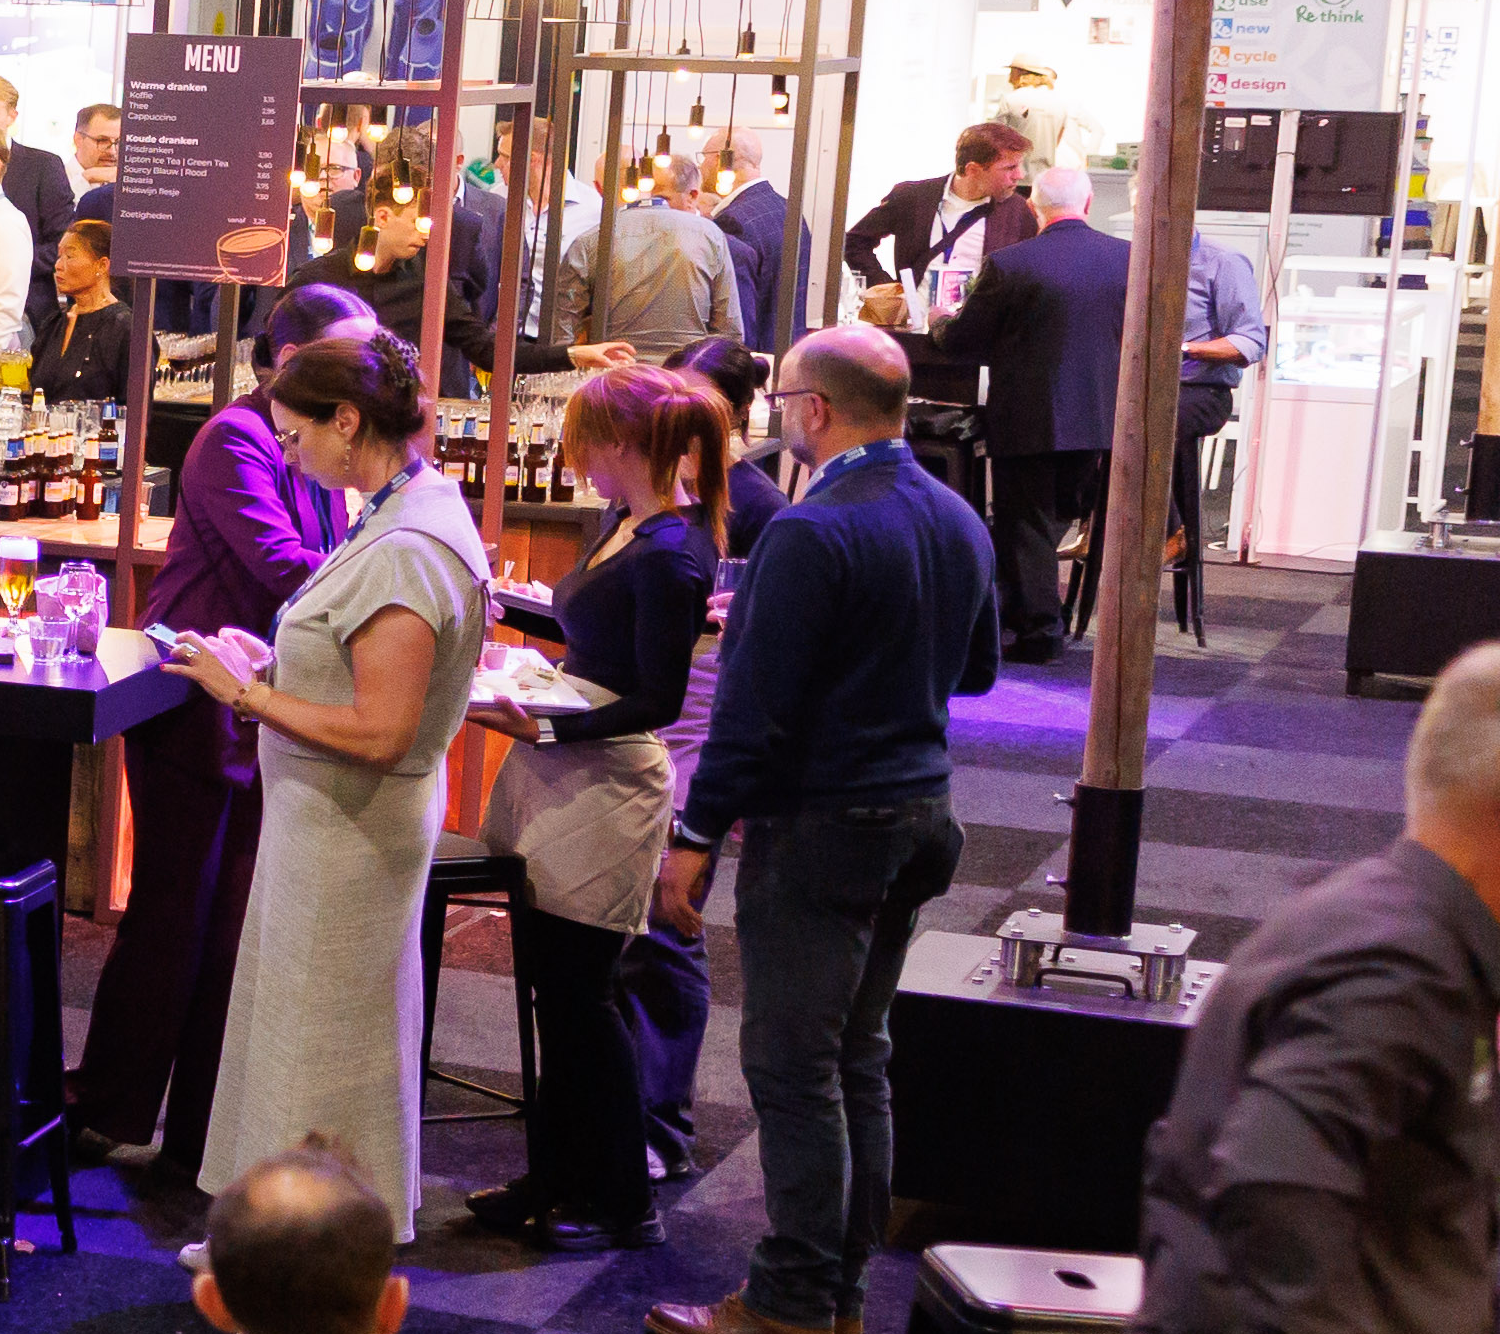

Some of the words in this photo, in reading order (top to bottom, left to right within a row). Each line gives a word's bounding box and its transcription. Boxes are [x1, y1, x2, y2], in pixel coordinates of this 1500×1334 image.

[1320, 10, 1363, 23] think
[1236, 24, 1270, 34] new
[184, 43, 241, 73] MENU
[1234, 50, 1277, 64] cycle
[130, 80, 166, 91] Warme
[167, 81, 208, 93] dranken
[1231, 78, 1286, 93] design
[129, 91, 154, 100] Koffie
[129, 101, 150, 110] Thee
[128, 112, 177, 123] Cappuccino
[126, 134, 157, 144] Koude
[158, 135, 199, 147] dranken
[125, 145, 174, 155] Frisdranken
[124, 155, 151, 166] Lipton
[166, 157, 181, 166] Tea
[187, 158, 212, 168] Green
[214, 159, 229, 168] Tea
[153, 166, 179, 176] Blauw
[185, 168, 208, 178] Rood
[120, 209, 173, 221] Zoetigheden
